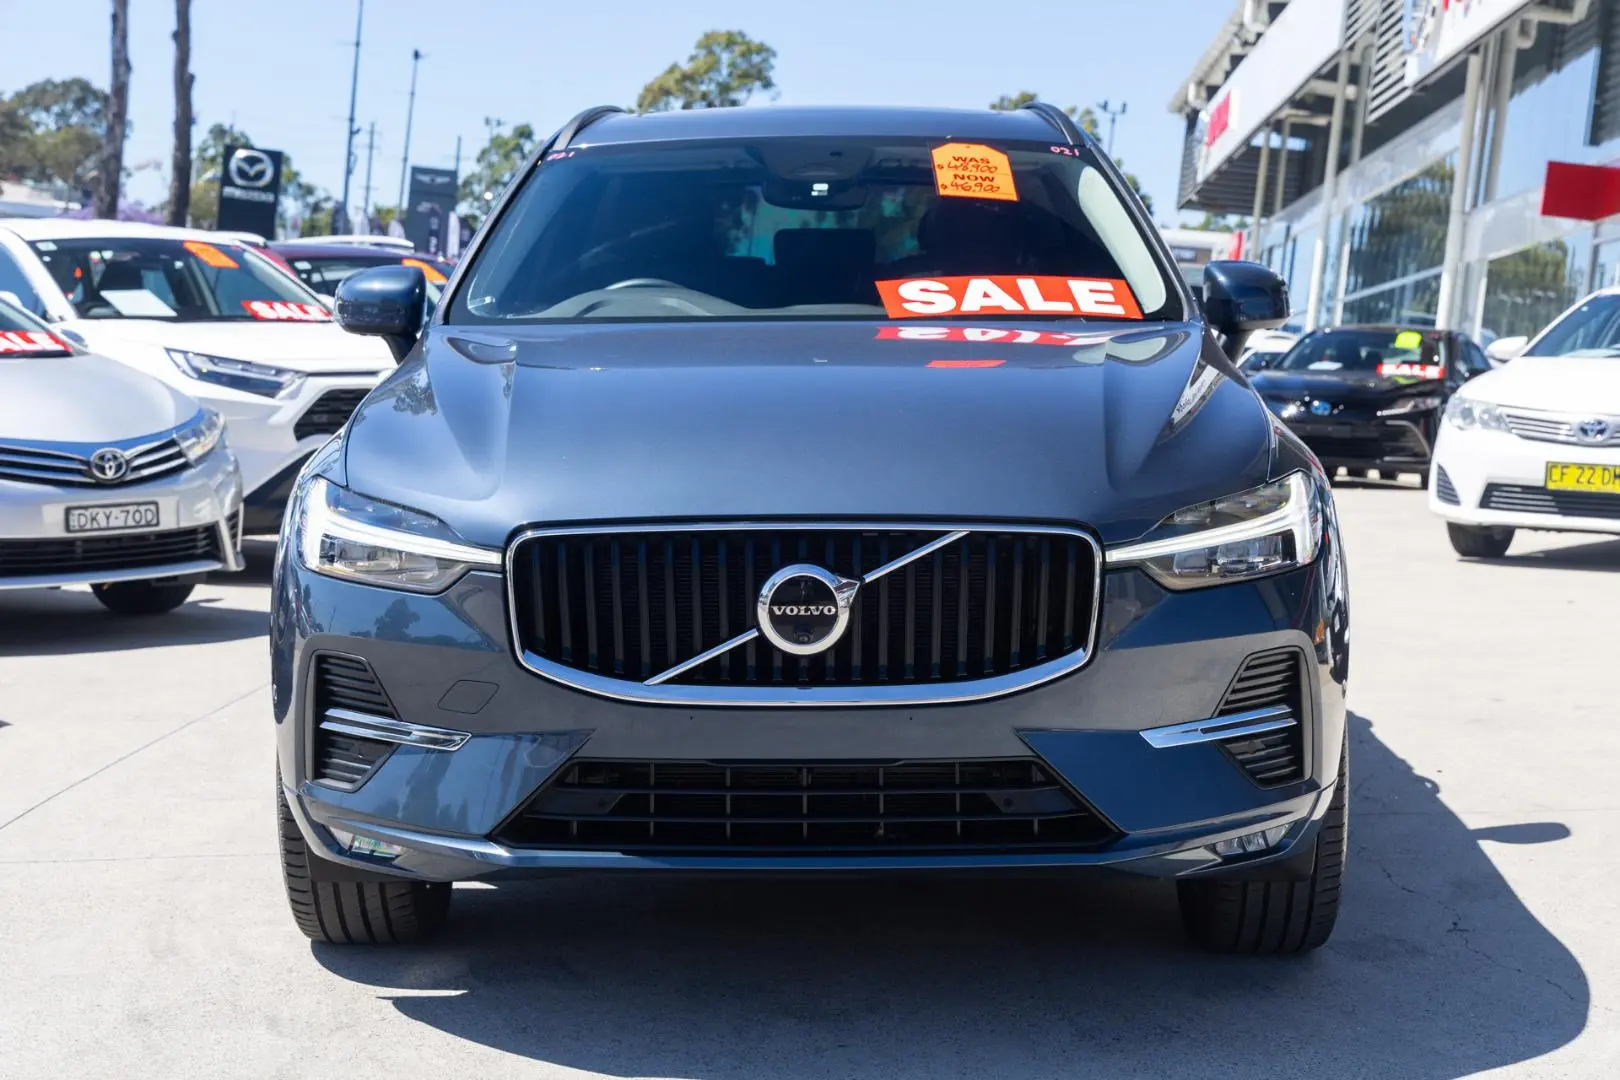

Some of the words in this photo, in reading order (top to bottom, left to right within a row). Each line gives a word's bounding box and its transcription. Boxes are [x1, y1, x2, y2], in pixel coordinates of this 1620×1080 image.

[1050, 146, 1080, 156] 021
[952, 156, 991, 164] WAS
[953, 174, 994, 182] NOW
[897, 278, 1126, 314] SALE
[250, 301, 331, 320] SALE
[0, 332, 65, 352] ALE
[1549, 464, 1571, 483] CF
[1576, 466, 1597, 485] 22
[770, 605, 837, 616] VOLVO
